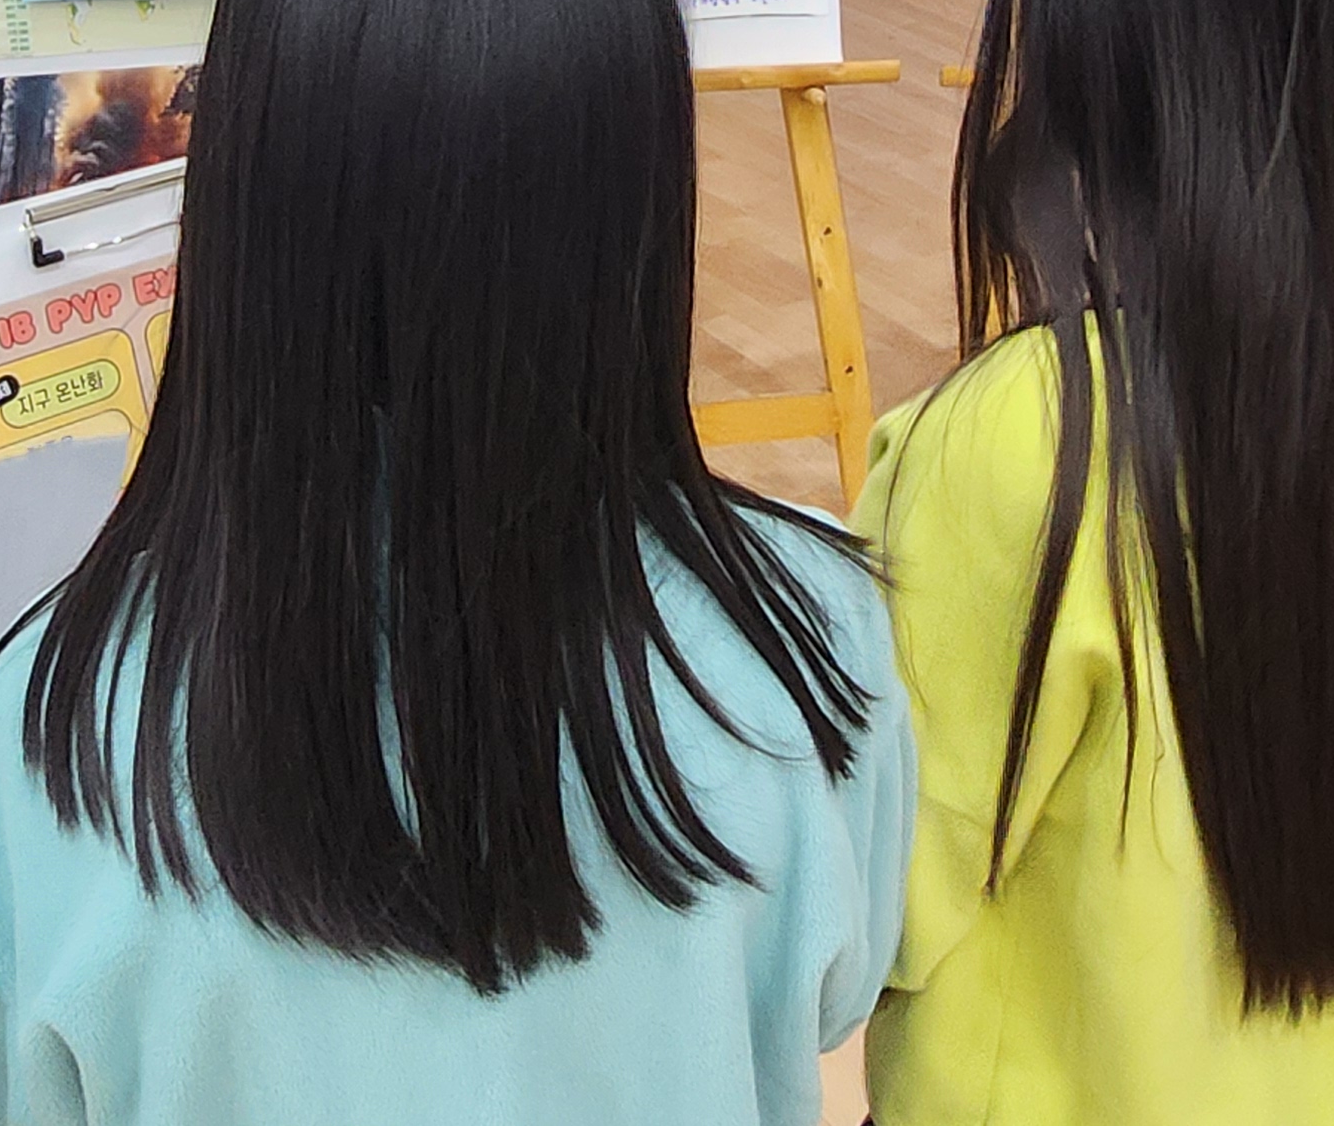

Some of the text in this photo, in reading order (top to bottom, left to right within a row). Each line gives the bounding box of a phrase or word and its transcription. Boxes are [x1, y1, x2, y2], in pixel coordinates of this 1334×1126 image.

[45, 282, 123, 335] PYP
[18, 368, 105, 416] 지구 온난화
